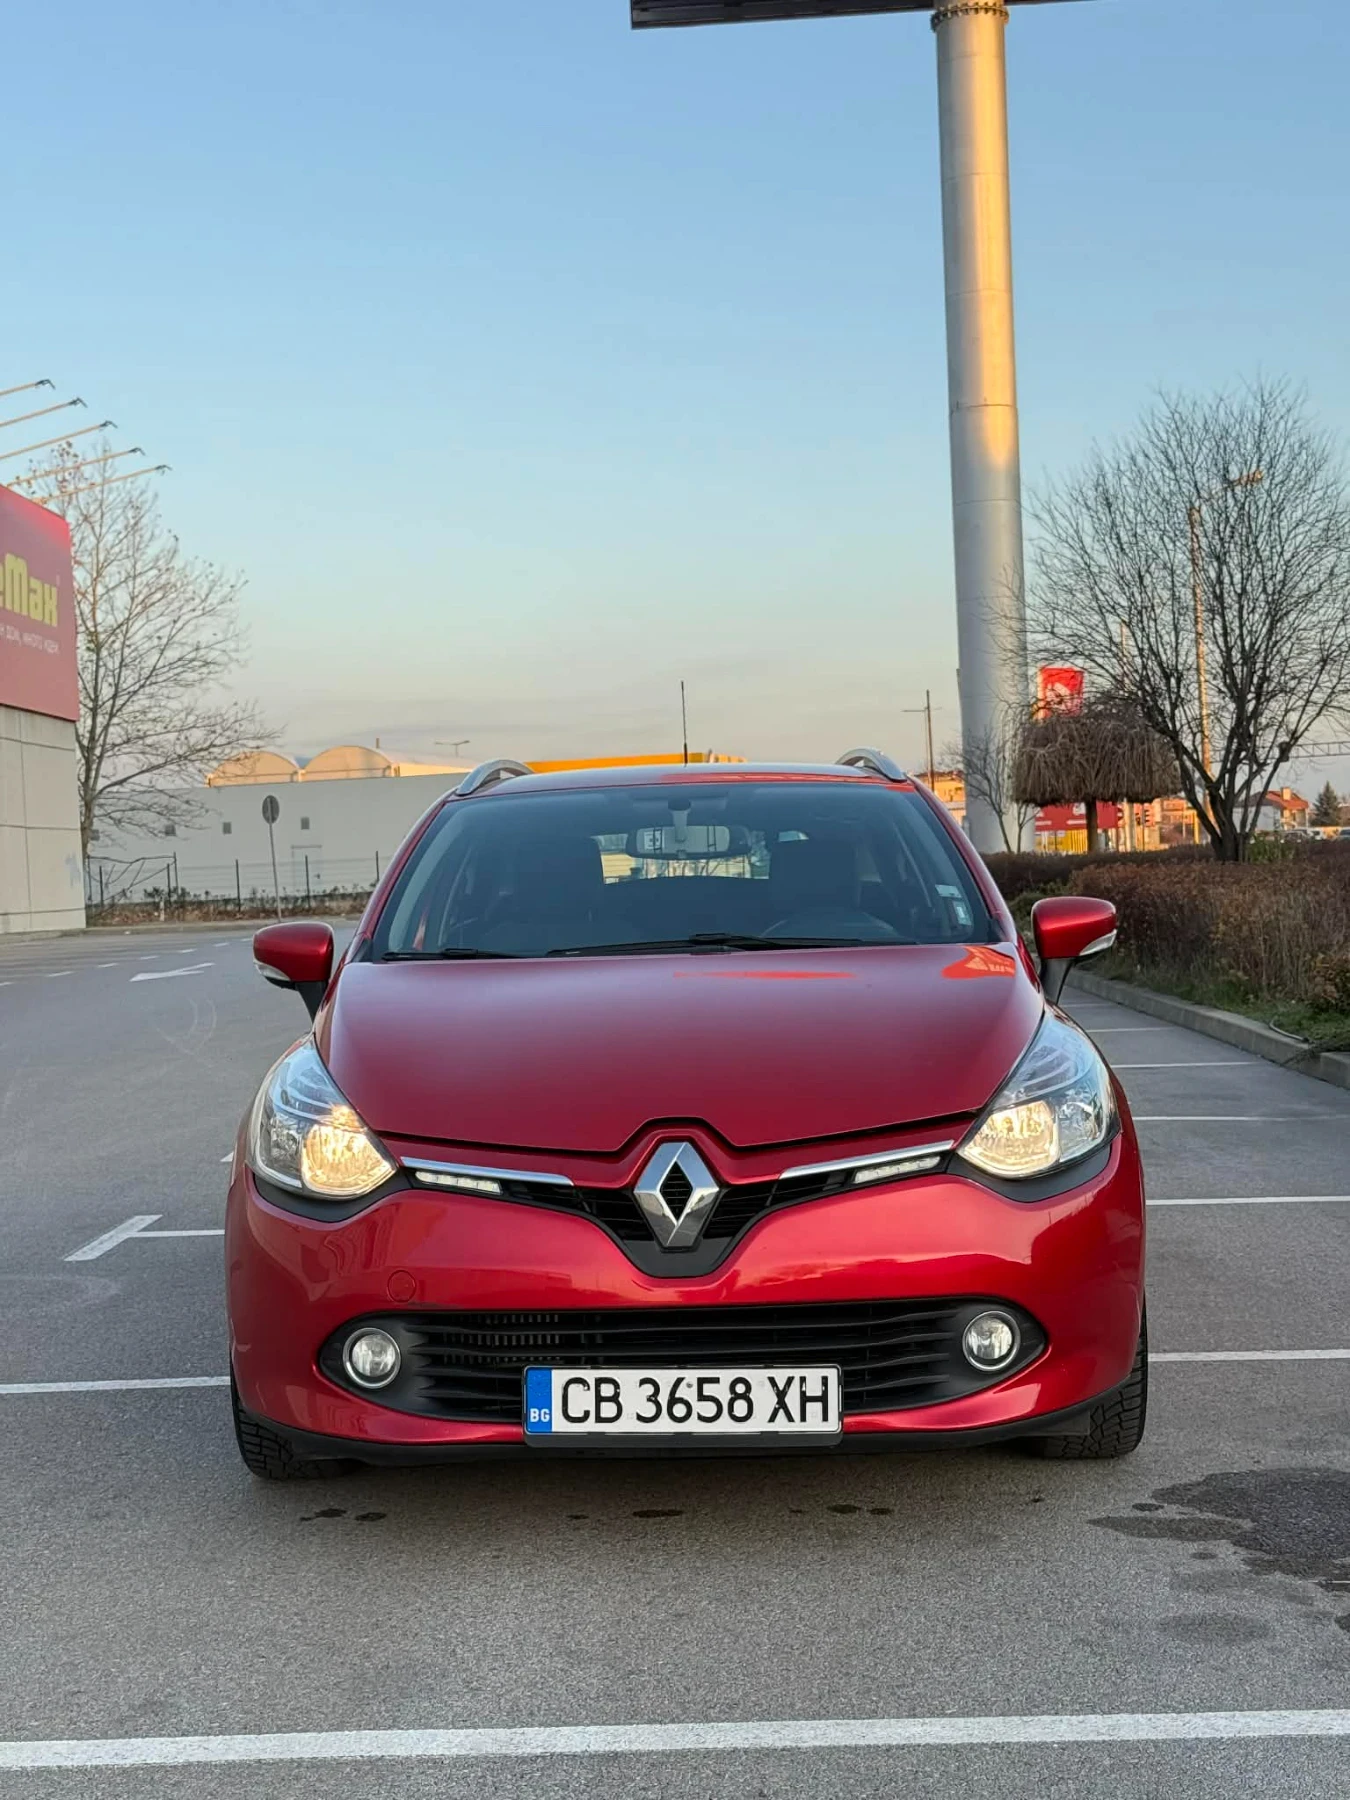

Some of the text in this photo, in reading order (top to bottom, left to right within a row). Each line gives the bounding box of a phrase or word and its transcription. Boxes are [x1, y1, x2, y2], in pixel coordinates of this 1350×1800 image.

[0, 552, 58, 628] Max
[529, 1407, 550, 1423] BG
[561, 1375, 829, 1424] CB 3658 XH
